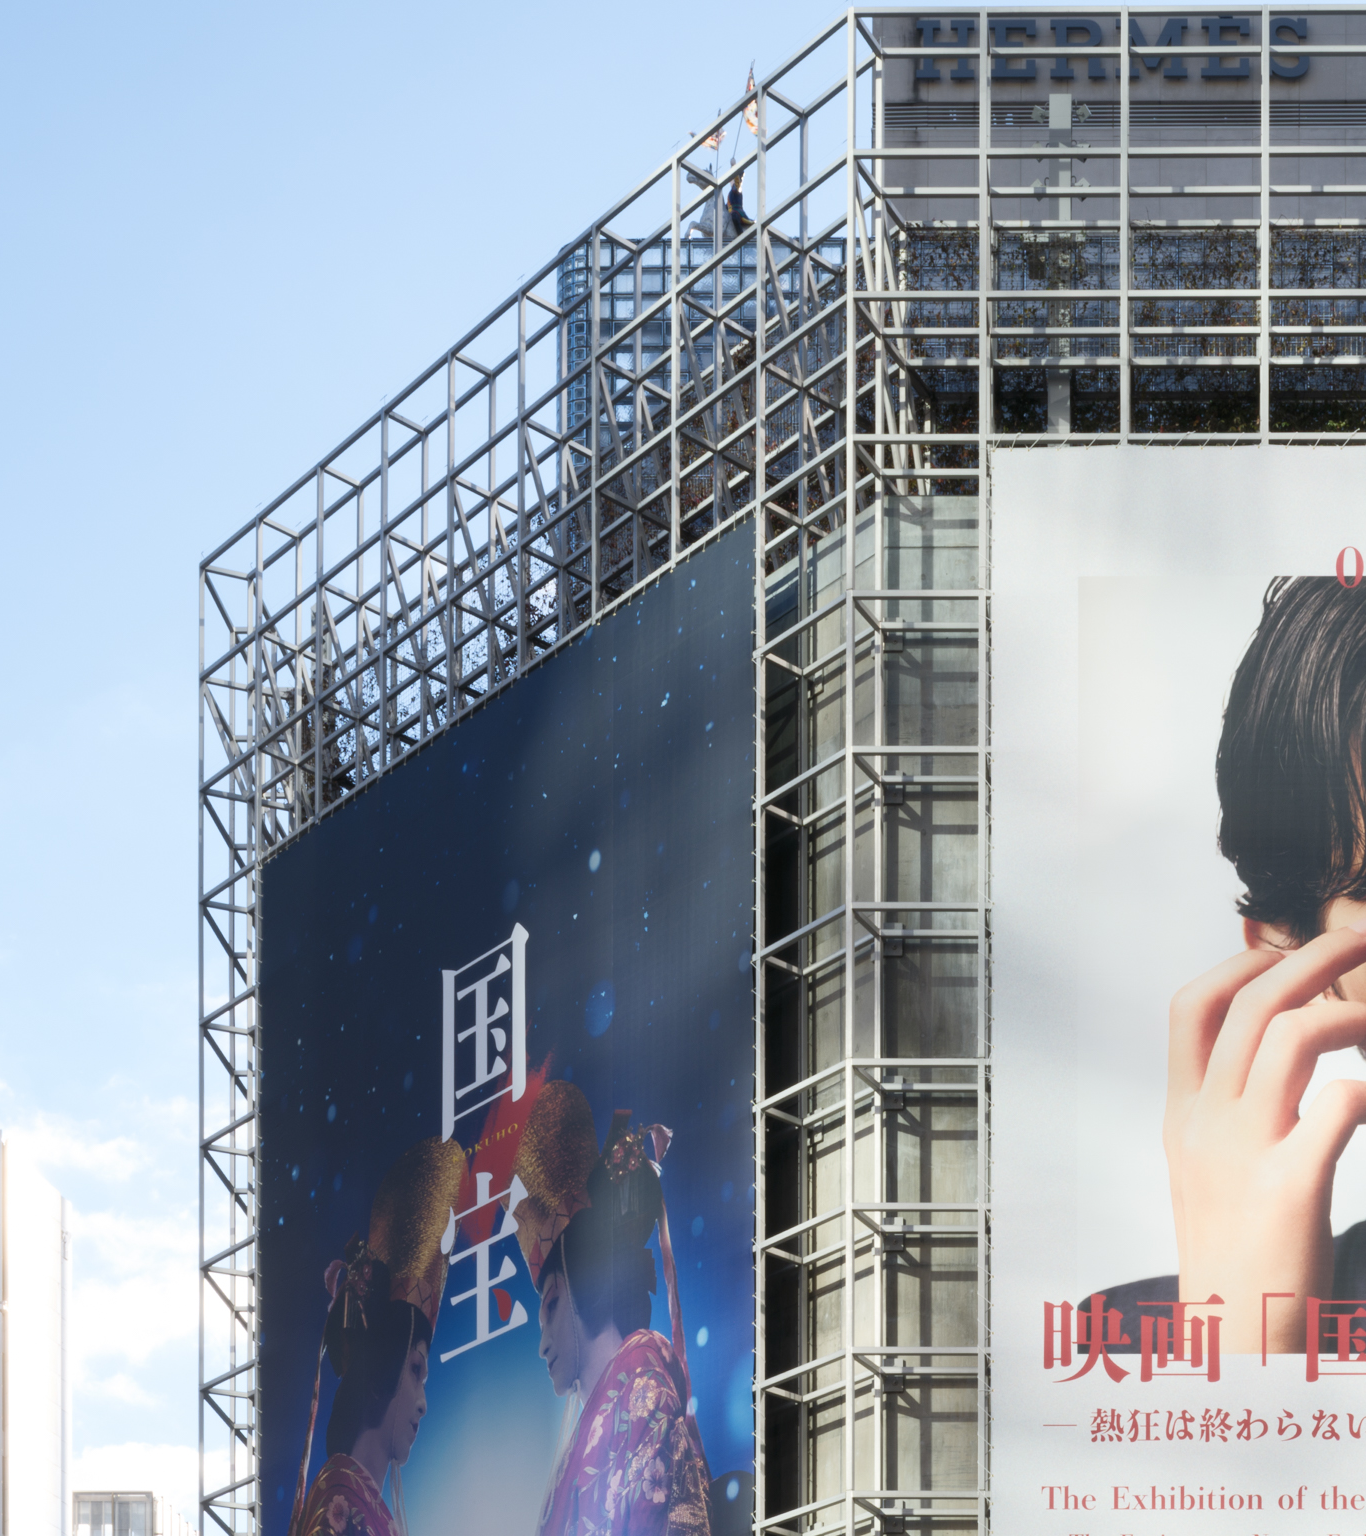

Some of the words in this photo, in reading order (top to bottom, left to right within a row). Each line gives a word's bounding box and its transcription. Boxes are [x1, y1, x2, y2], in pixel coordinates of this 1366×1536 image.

[916, 15, 1309, 82] HERMÈS
[440, 923, 528, 1363] 国宝
[1041, 1485, 1097, 1511] The
[1111, 1485, 1264, 1511] Exhibition
[1278, 1485, 1307, 1511] of
[1319, 1485, 1365, 1511] the
